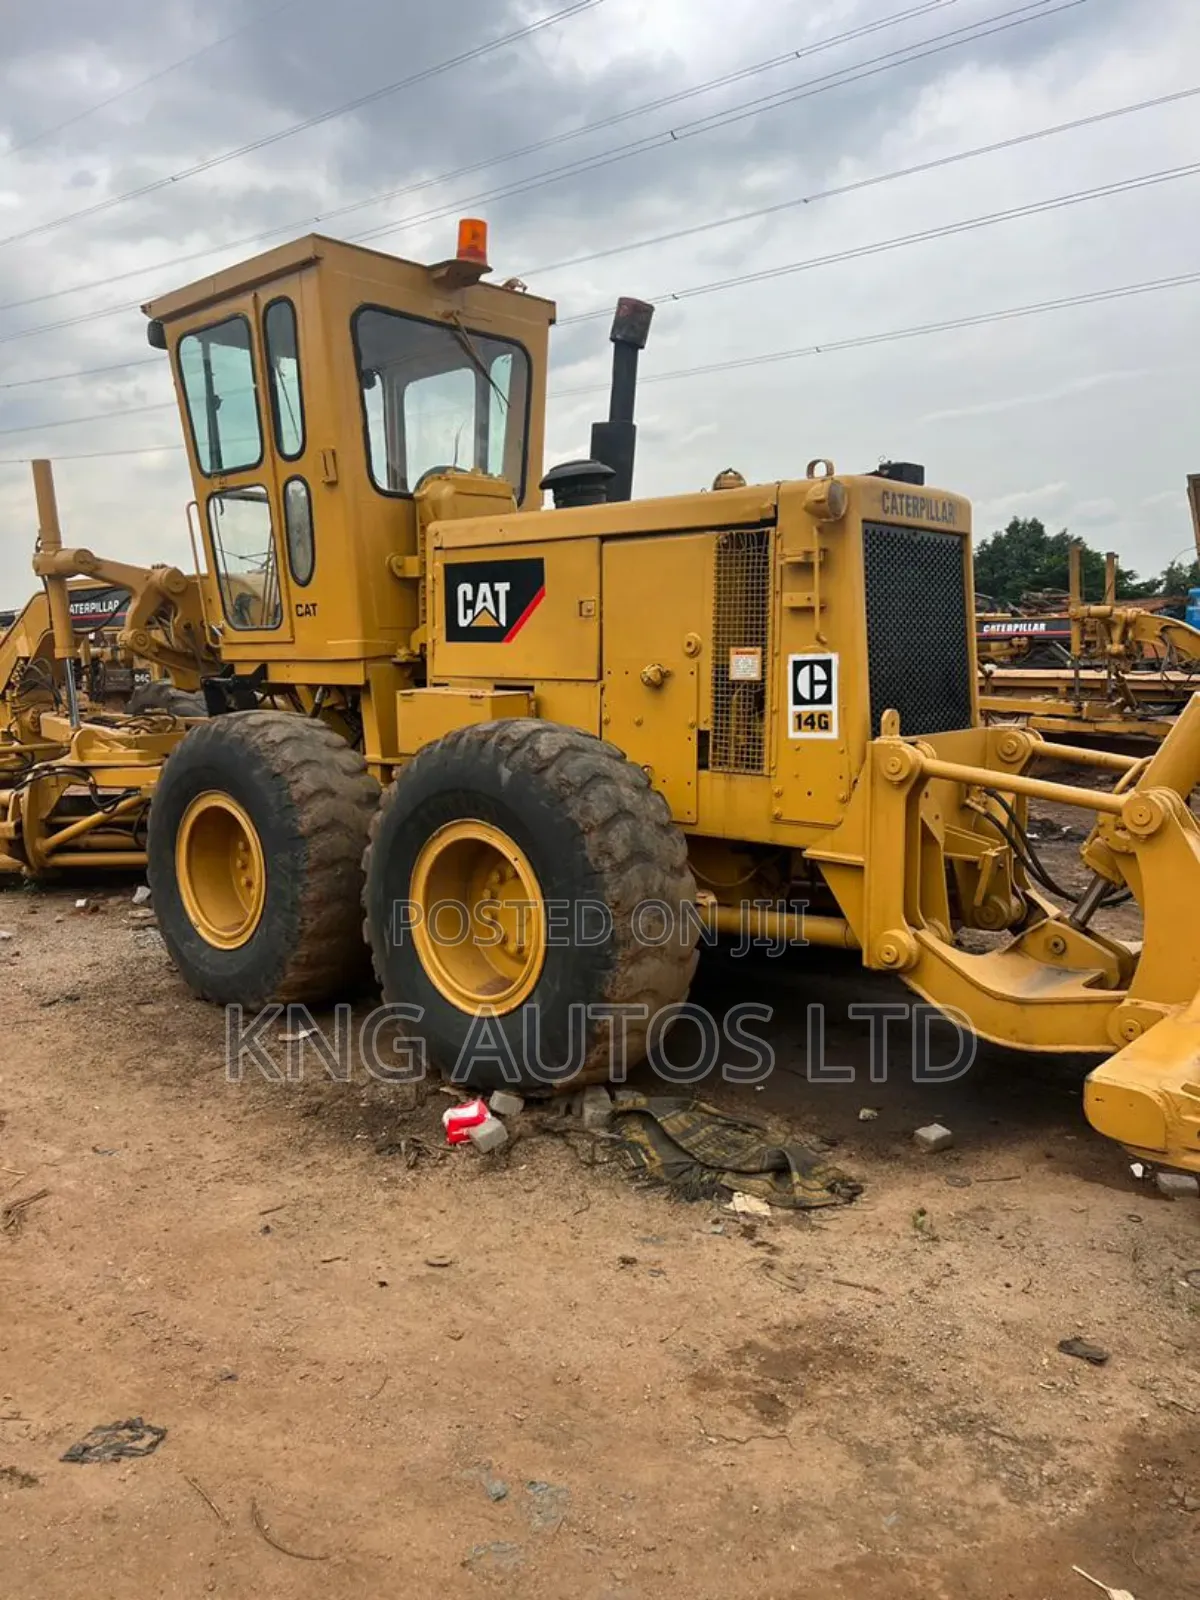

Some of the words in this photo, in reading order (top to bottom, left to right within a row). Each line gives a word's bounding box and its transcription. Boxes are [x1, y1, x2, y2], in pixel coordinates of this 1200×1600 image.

[881, 489, 957, 525] CATERPILLAR
[69, 599, 119, 615] ATERPILLAR
[295, 603, 318, 617] CAT
[457, 582, 510, 627] CAT
[983, 623, 1046, 632] CATERPILLAR
[795, 713, 829, 730] 14G
